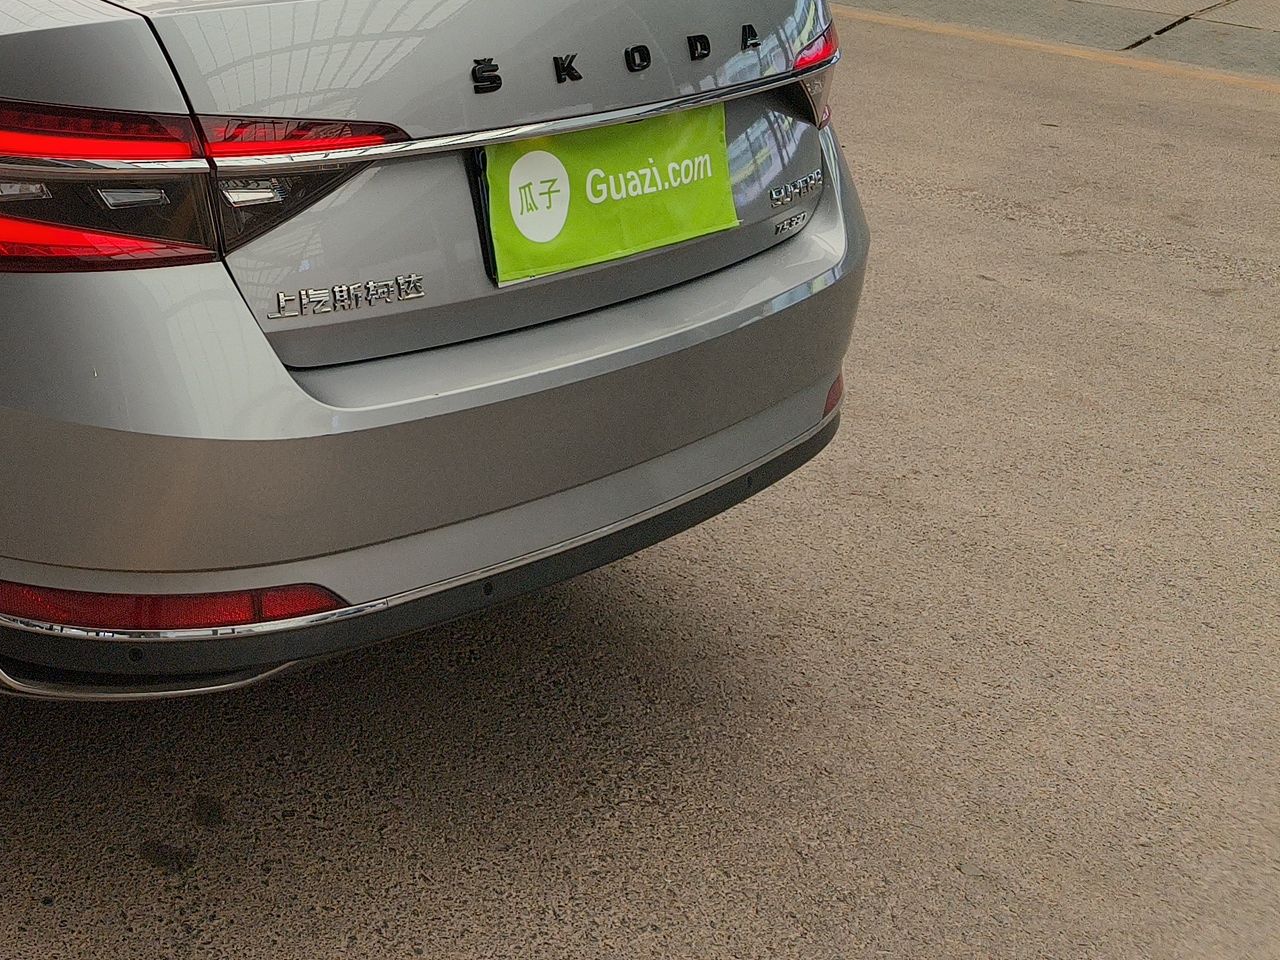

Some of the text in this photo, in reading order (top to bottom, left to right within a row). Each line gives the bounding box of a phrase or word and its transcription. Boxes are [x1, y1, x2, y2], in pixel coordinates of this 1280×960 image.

[471, 23, 761, 94] ŠKODA
[518, 177, 561, 216] 瓜子
[586, 153, 712, 205] Guazi.com
[267, 273, 426, 319] 上汽斯柯达
